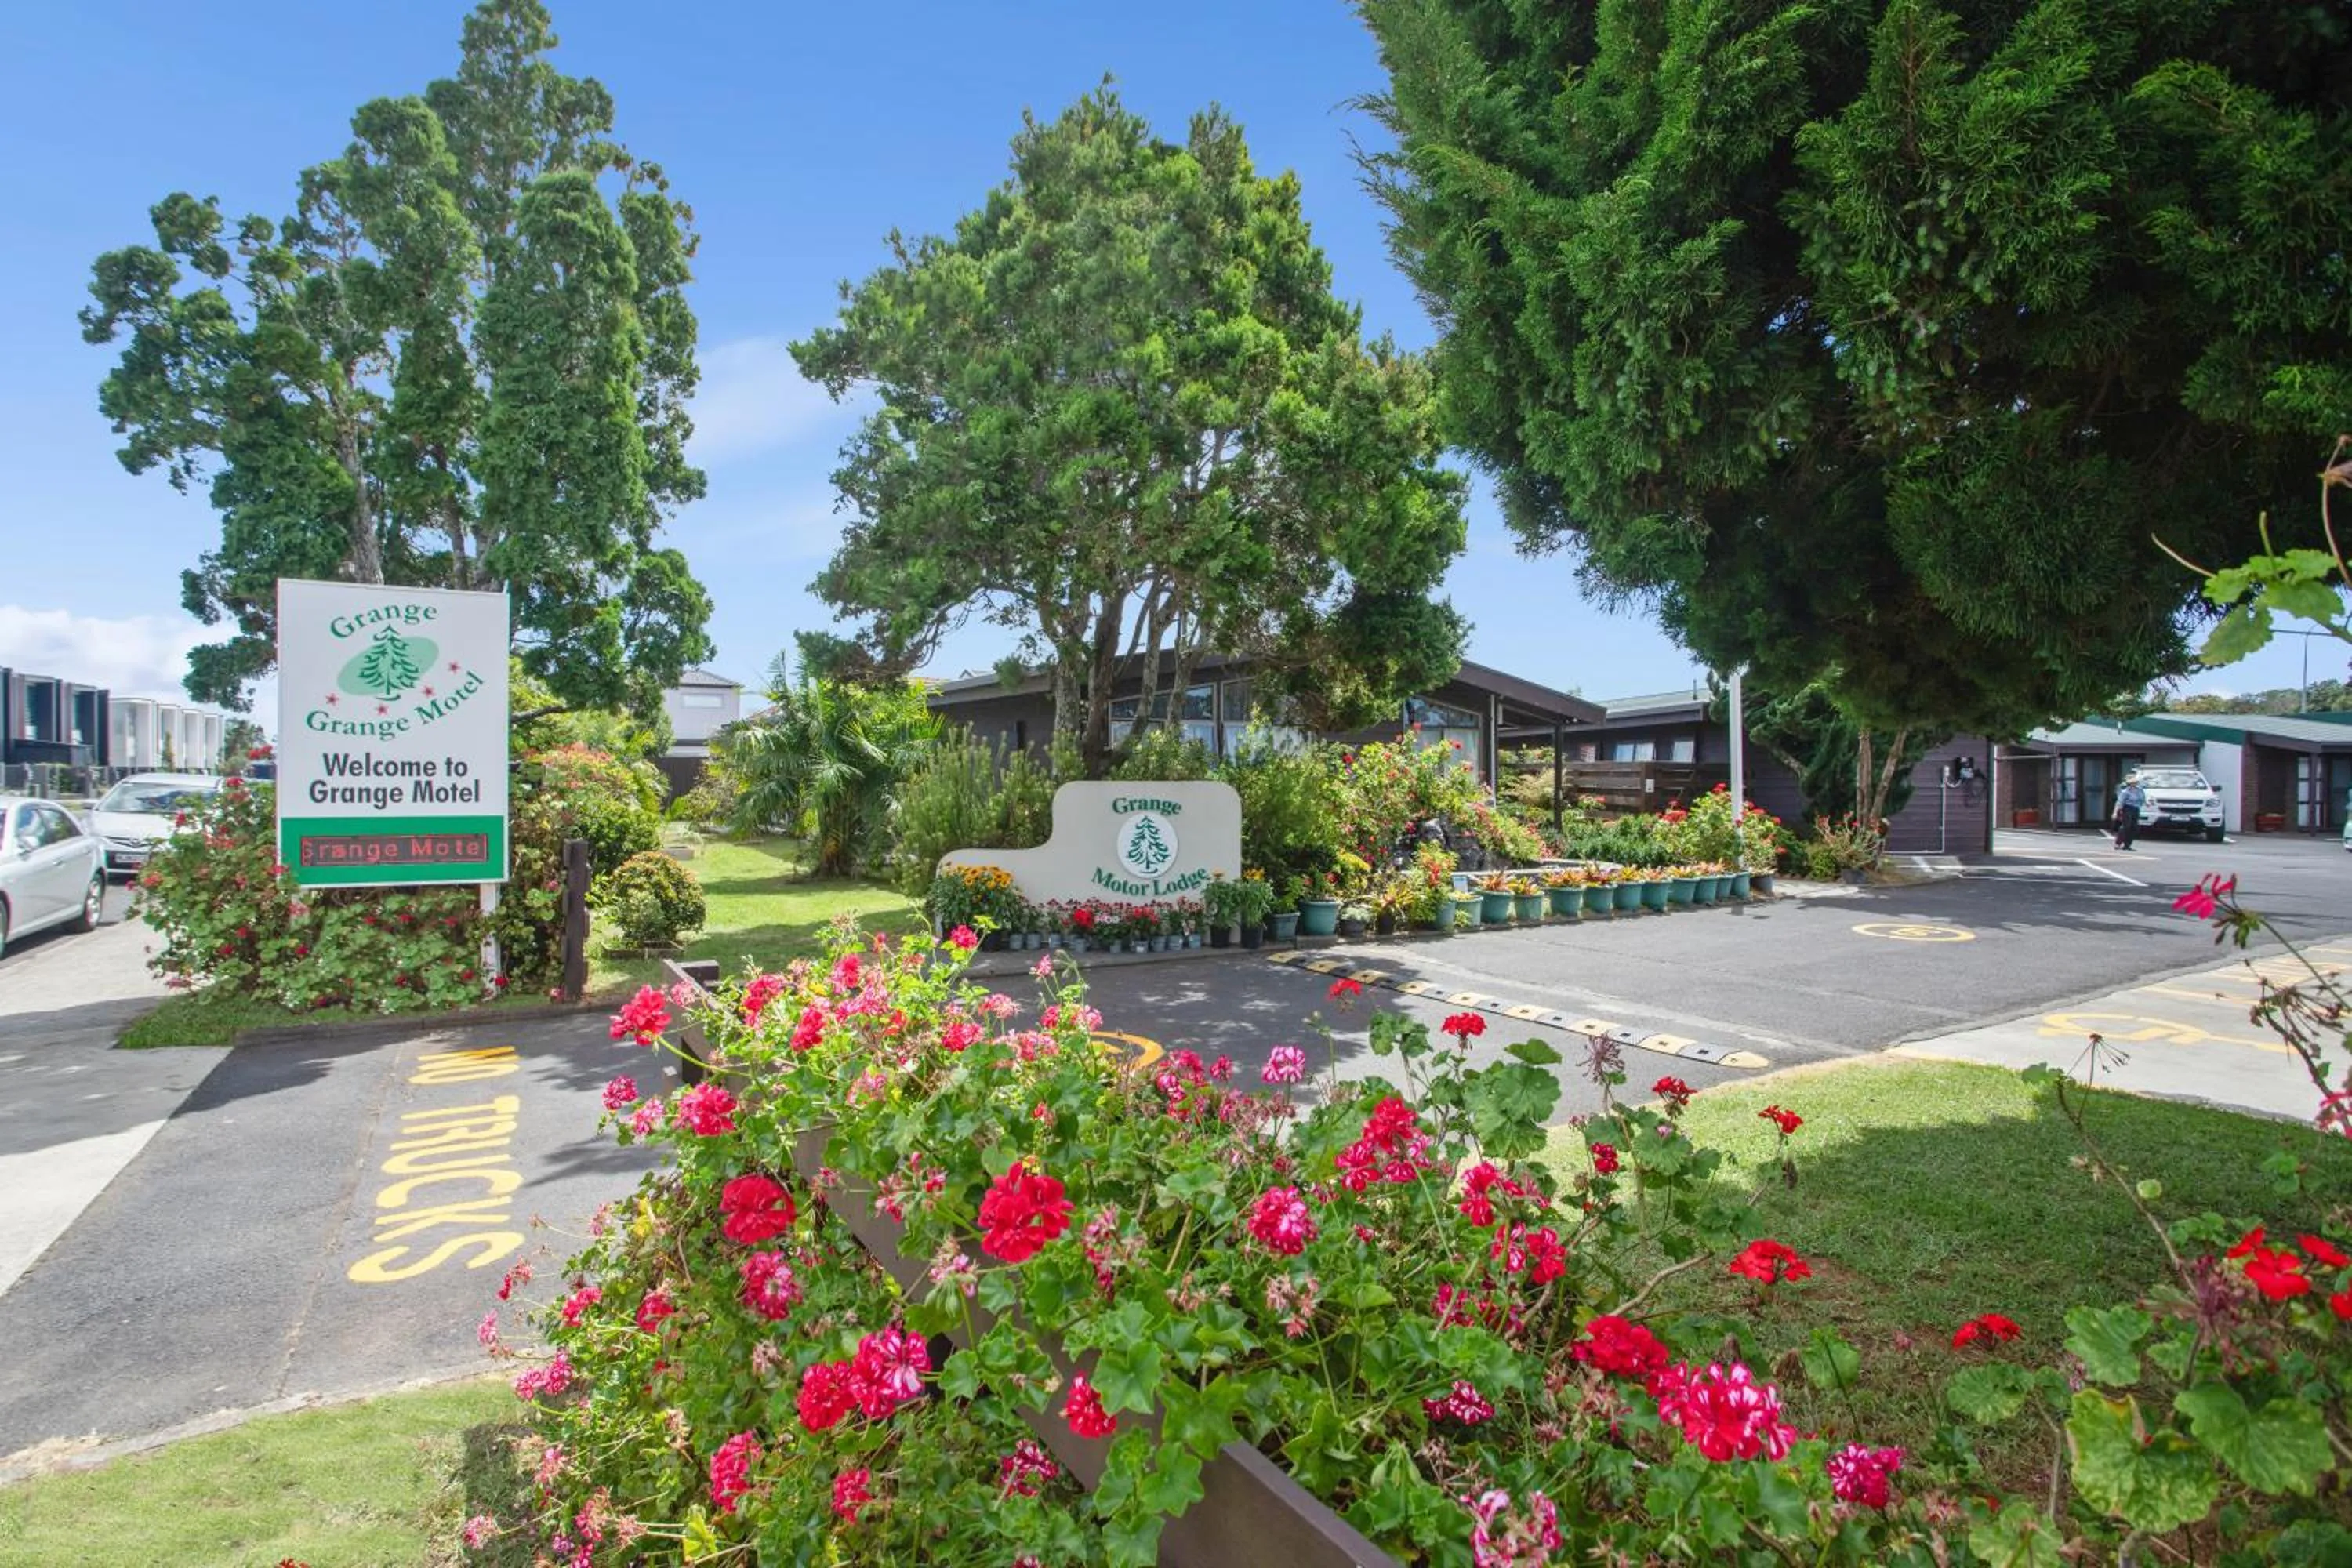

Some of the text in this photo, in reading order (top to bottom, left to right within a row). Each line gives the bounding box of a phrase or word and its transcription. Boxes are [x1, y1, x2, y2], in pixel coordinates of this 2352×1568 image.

[329, 603, 438, 640] Grange
[306, 670, 485, 742] Grange Motel
[323, 752, 469, 778] Welcome to
[309, 779, 480, 811] Grange Motel
[1112, 797, 1182, 816] Grange
[1091, 866, 1211, 896] Motor Lodge
[347, 1045, 525, 1283] NO TRUCKS
